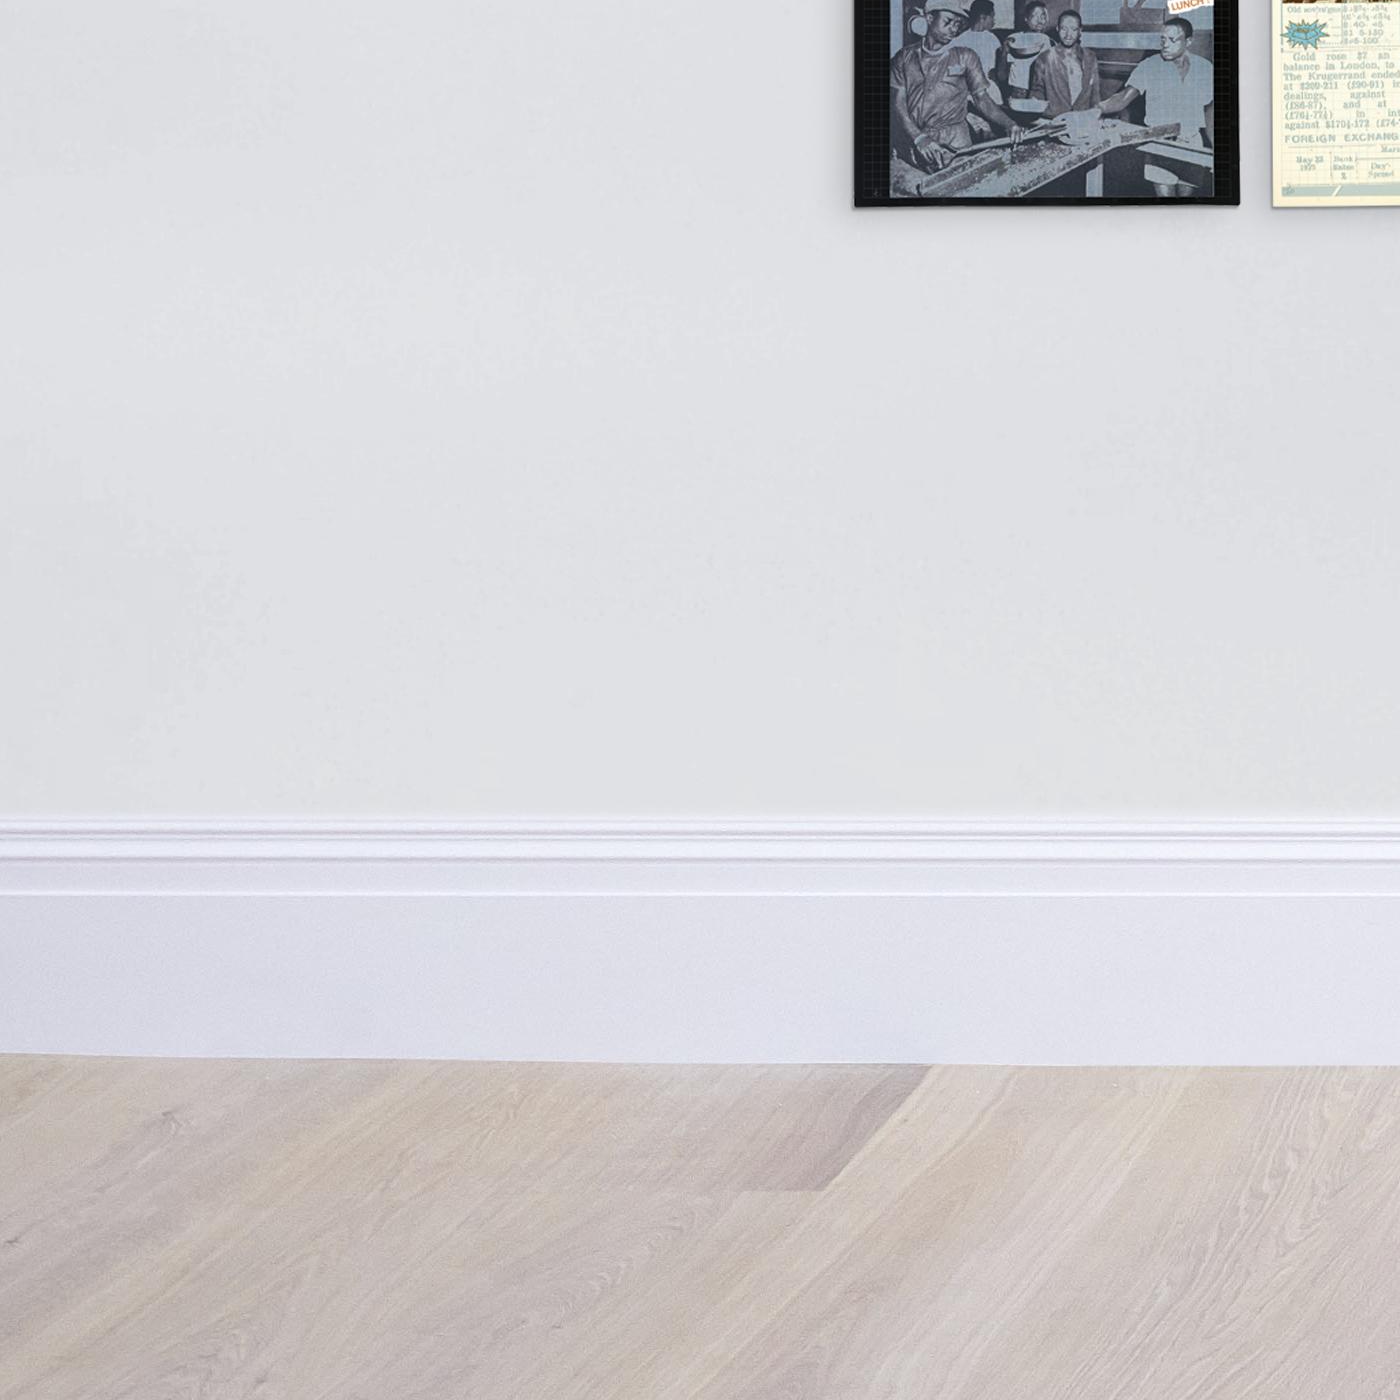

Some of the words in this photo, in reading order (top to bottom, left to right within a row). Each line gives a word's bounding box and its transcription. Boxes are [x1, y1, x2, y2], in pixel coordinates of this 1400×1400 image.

[1171, 0, 1204, 11] LUNCH
[1293, 52, 1316, 61] Gold
[1283, 62, 1320, 71] balance
[1325, 62, 1335, 70] in
[1340, 61, 1379, 71] London,
[1283, 73, 1302, 81] The
[1308, 71, 1366, 82] Krugerrand
[1371, 70, 1400, 79] ended
[1284, 134, 1336, 143] FOREIGN
